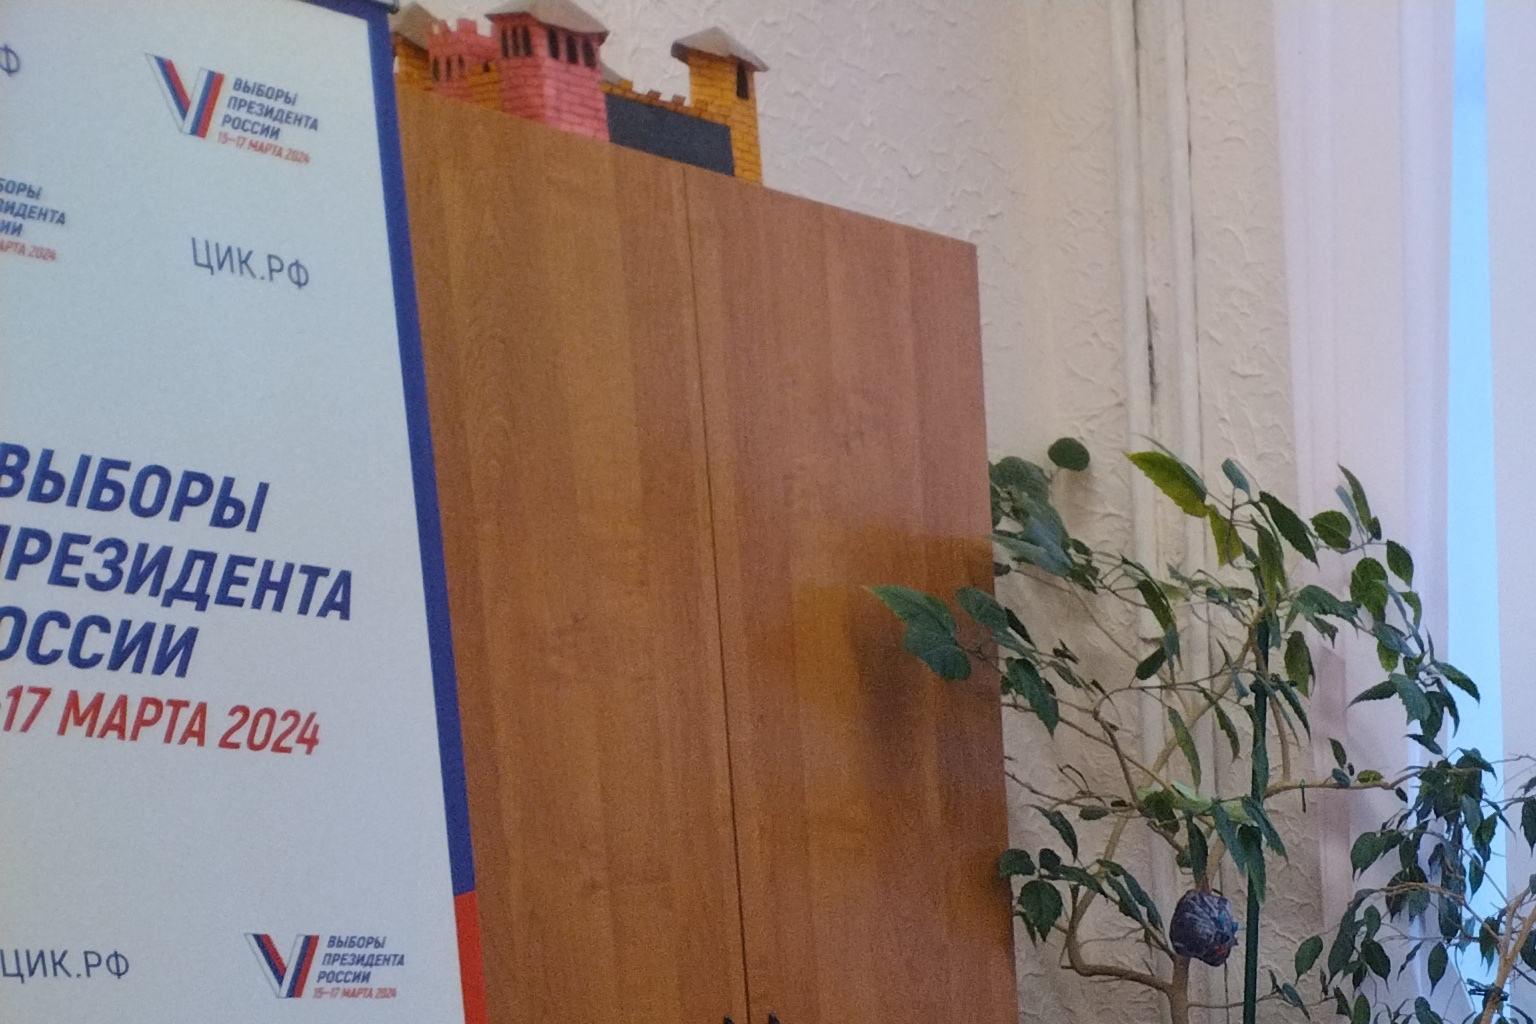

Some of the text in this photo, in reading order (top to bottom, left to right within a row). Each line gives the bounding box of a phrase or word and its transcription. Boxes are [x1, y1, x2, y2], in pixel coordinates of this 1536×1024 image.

[232, 77, 297, 106] ВЫБОРЫ
[226, 96, 319, 131] ПРЕЗИДЕНТА
[221, 114, 281, 141] РОССИИ
[247, 138, 283, 159] МАРТА
[0, 198, 66, 226] ИДЕНТА
[191, 236, 310, 290] ЦИК.РФ
[57, 689, 208, 747] МАРТА
[218, 703, 320, 755] 2024
[327, 935, 386, 949] ВЫБОРЫ
[0, 948, 130, 984] ЦИК.РФ
[321, 952, 405, 968] ПРЕЗИДЕНТА
[316, 970, 371, 984] РОССИИ
[341, 987, 373, 998] МАРТА
